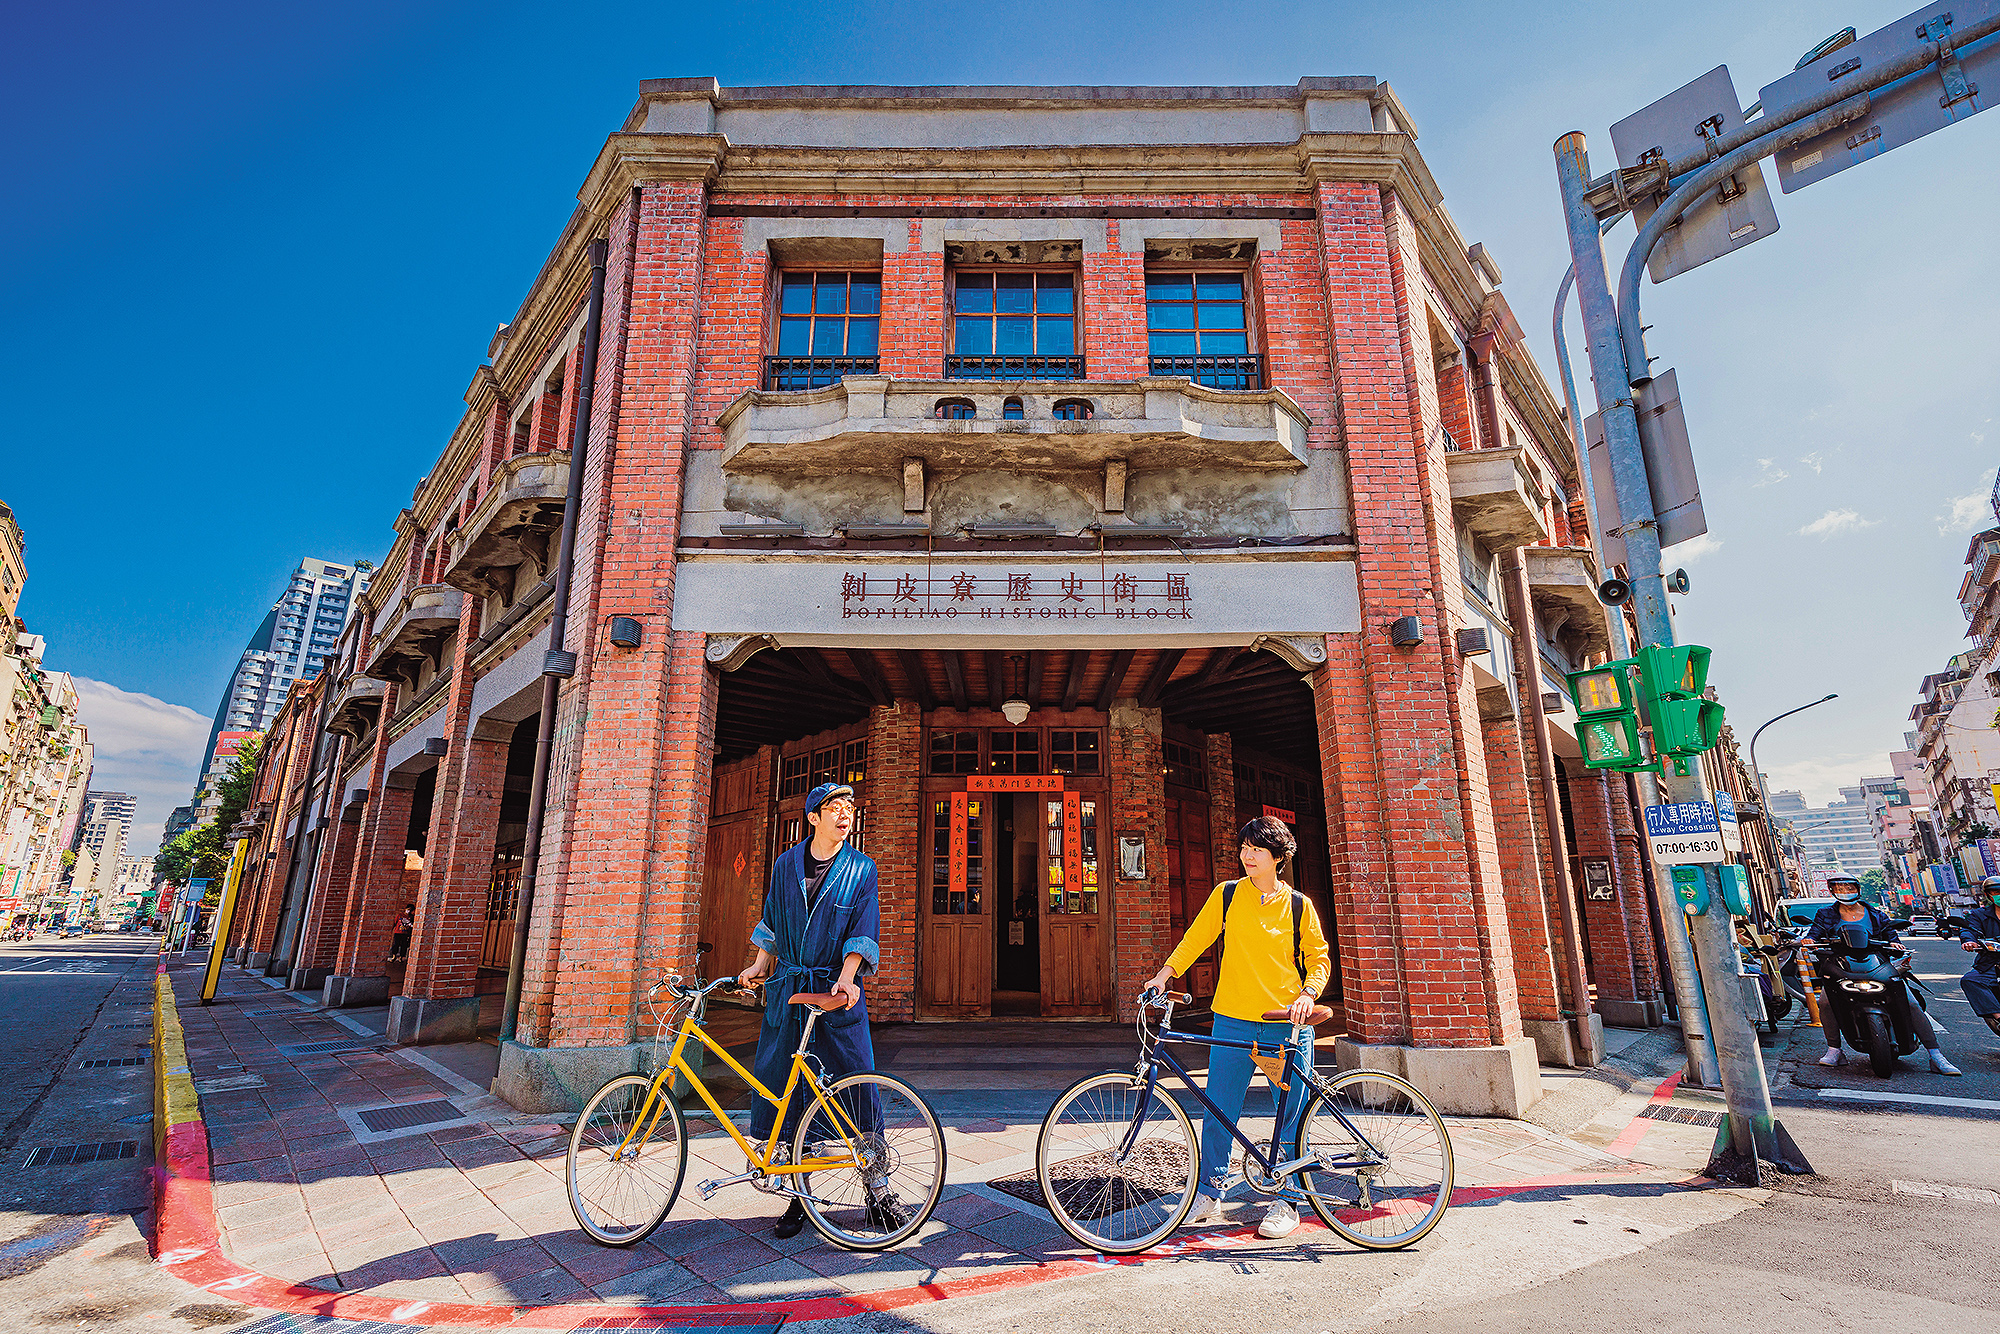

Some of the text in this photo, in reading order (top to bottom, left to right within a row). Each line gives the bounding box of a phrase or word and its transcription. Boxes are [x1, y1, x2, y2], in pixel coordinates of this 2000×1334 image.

[840, 571, 1193, 603] 剝皮寮歷史街區
[841, 607, 1193, 620] BOPILIAO HISTORIC BLOCK
[1646, 802, 1715, 827] 行人專用時相
[1650, 822, 1717, 835] 4-way Crossing
[1656, 840, 1719, 855] 07:00-16:30
